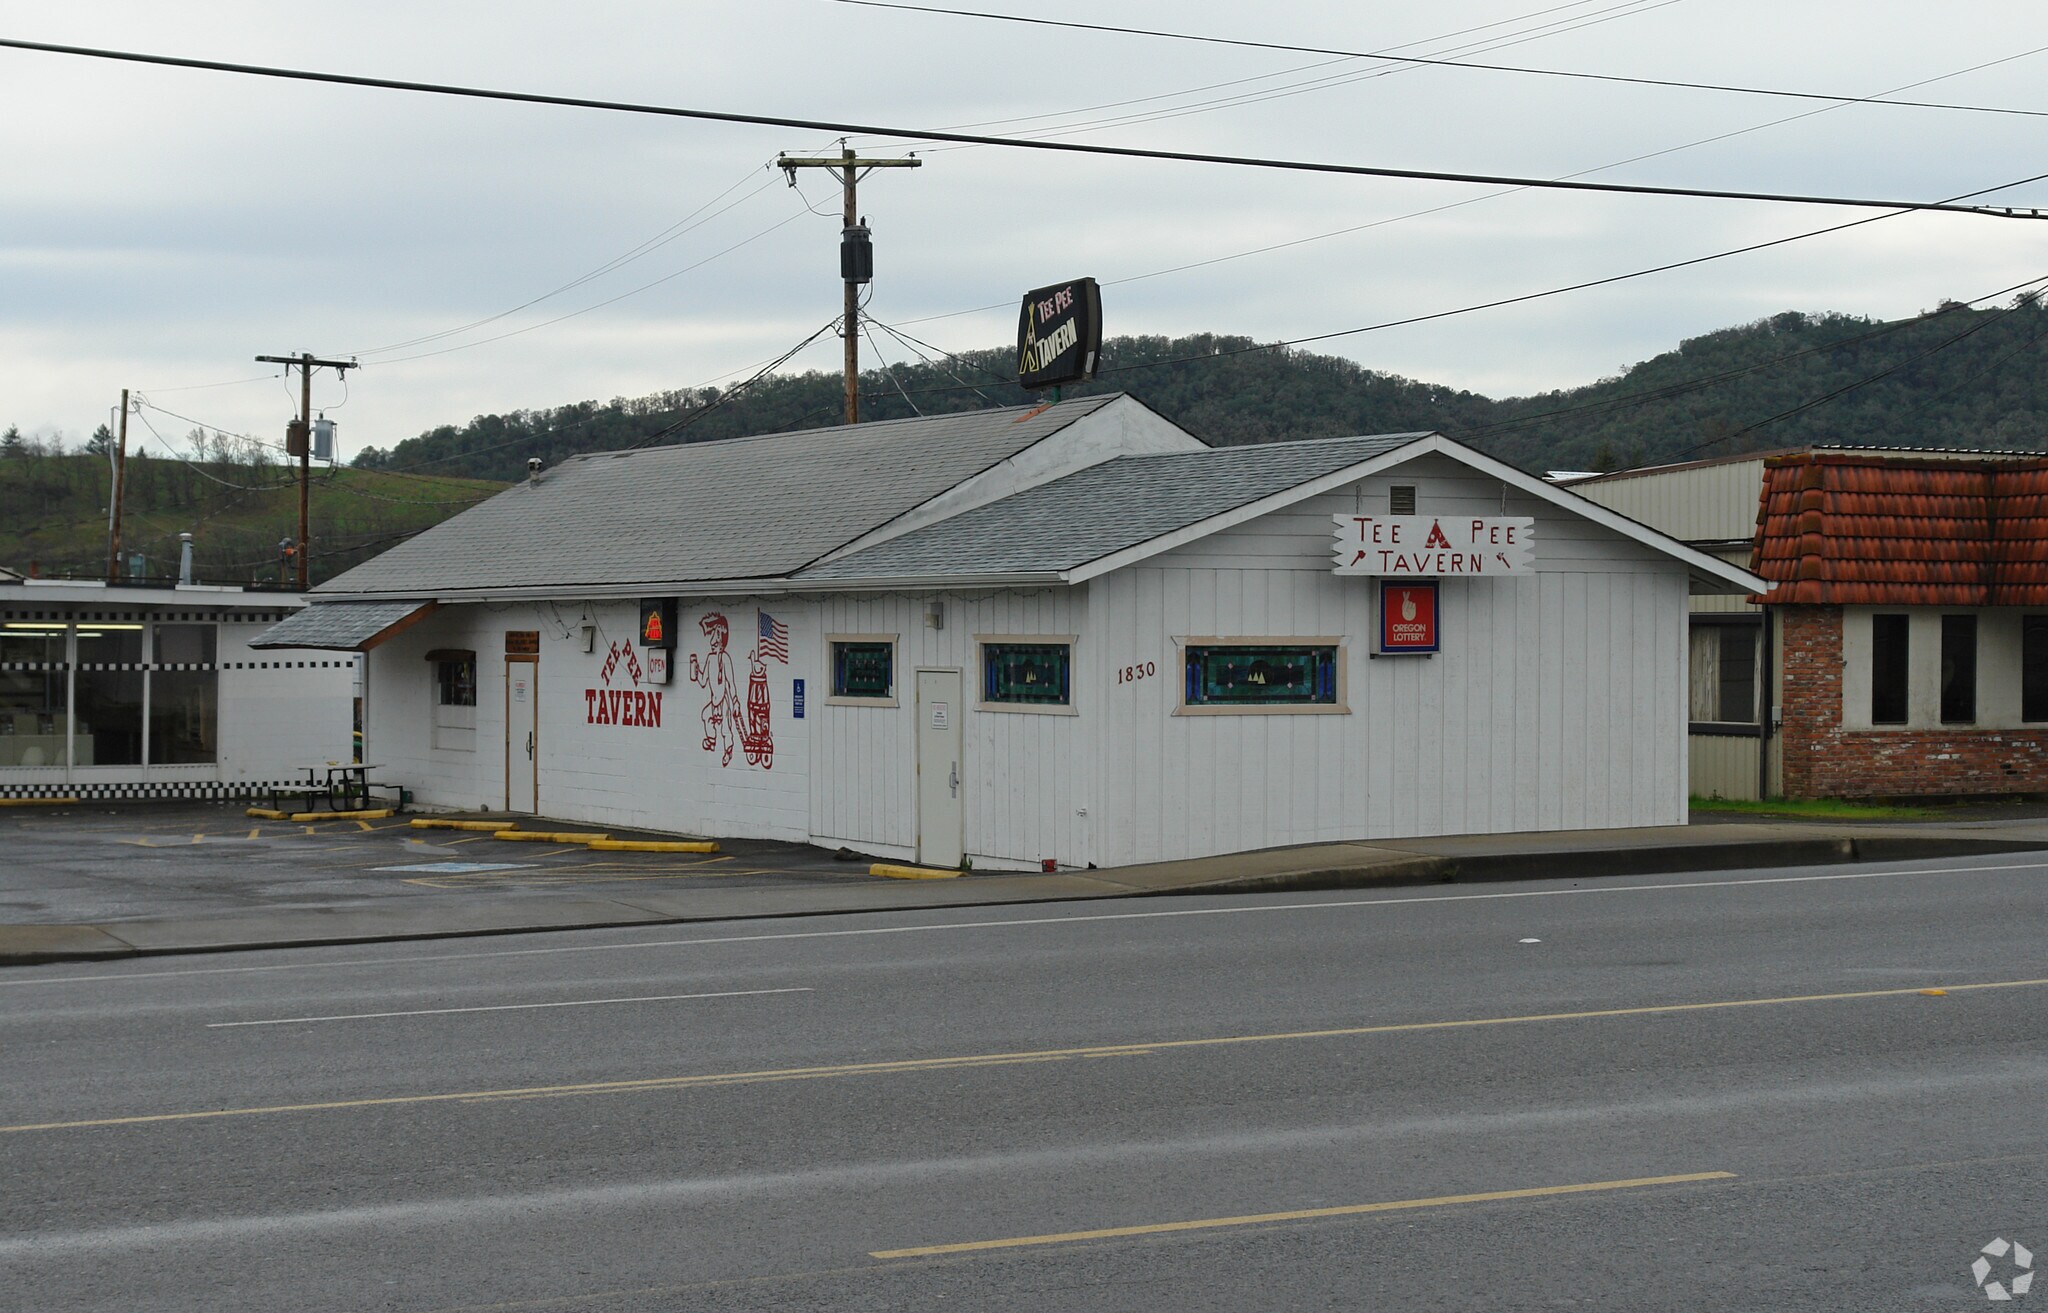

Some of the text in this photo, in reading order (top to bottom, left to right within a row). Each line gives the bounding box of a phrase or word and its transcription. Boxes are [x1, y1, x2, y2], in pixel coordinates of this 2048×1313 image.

[1037, 286, 1074, 323] TEE PEE
[1036, 317, 1078, 369] TAVERN
[1353, 518, 1516, 544] TEE PEE
[1378, 551, 1482, 573] TAVERN
[1392, 624, 1426, 633] OREGON
[1393, 633, 1426, 642] LOTTERY
[601, 637, 642, 687] TEE PEE
[649, 658, 665, 674] OPEN
[1118, 661, 1155, 685] 1830
[585, 689, 663, 728] TAVERN
